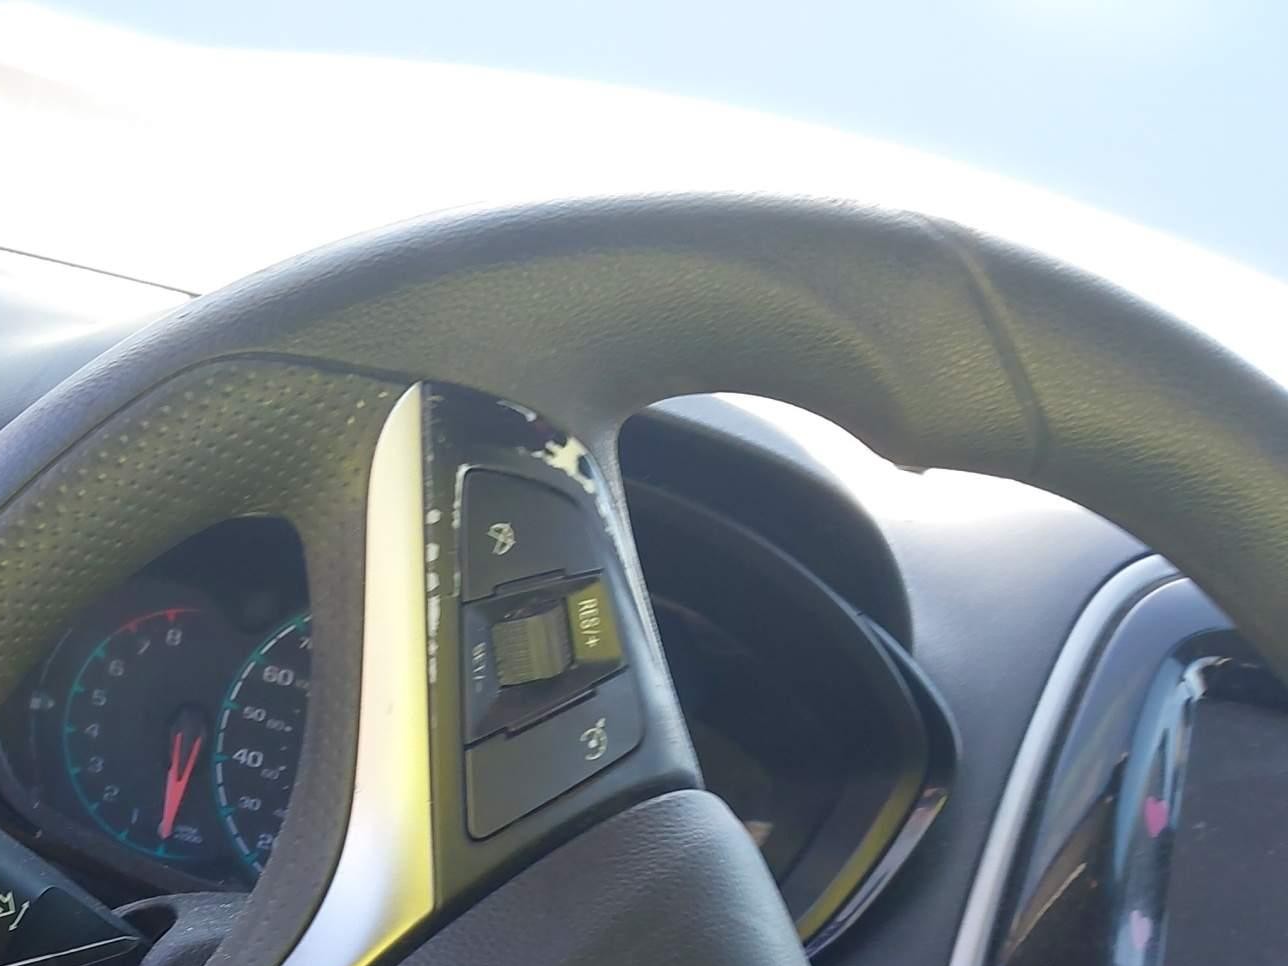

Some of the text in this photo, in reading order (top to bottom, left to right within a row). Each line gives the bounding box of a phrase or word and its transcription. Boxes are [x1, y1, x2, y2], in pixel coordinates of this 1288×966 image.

[165, 629, 182, 646] 8
[262, 666, 294, 687] 60
[92, 690, 107, 706] 5
[242, 706, 267, 723] 50
[85, 723, 101, 737] 4
[89, 757, 104, 773] 3
[232, 748, 263, 768] 40
[238, 796, 262, 811] 30
